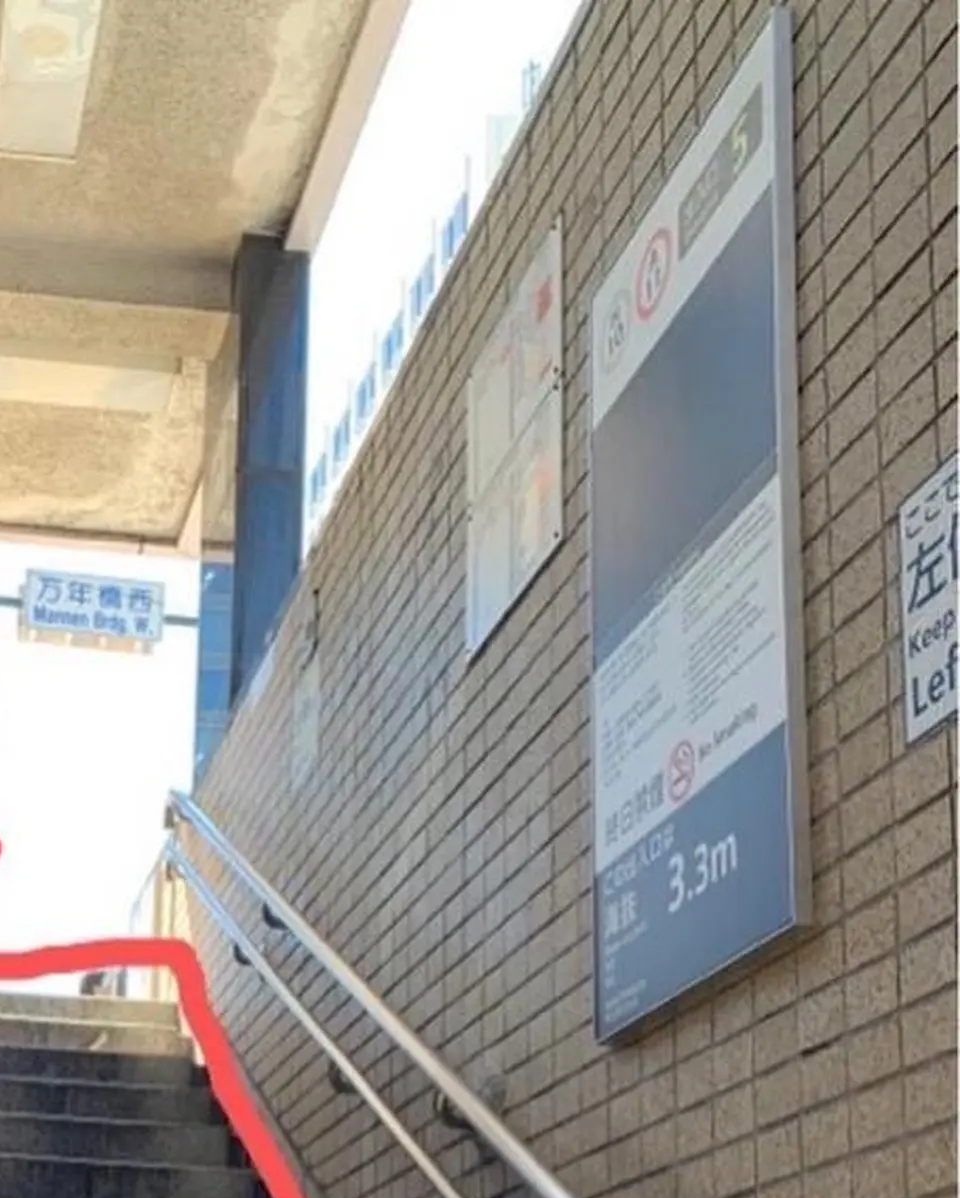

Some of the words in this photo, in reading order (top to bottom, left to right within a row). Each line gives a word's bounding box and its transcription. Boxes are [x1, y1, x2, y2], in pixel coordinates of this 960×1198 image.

[38, 577, 152, 613] 万年橋西
[909, 608, 955, 658] Keep
[667, 833, 738, 914] 3.3m
